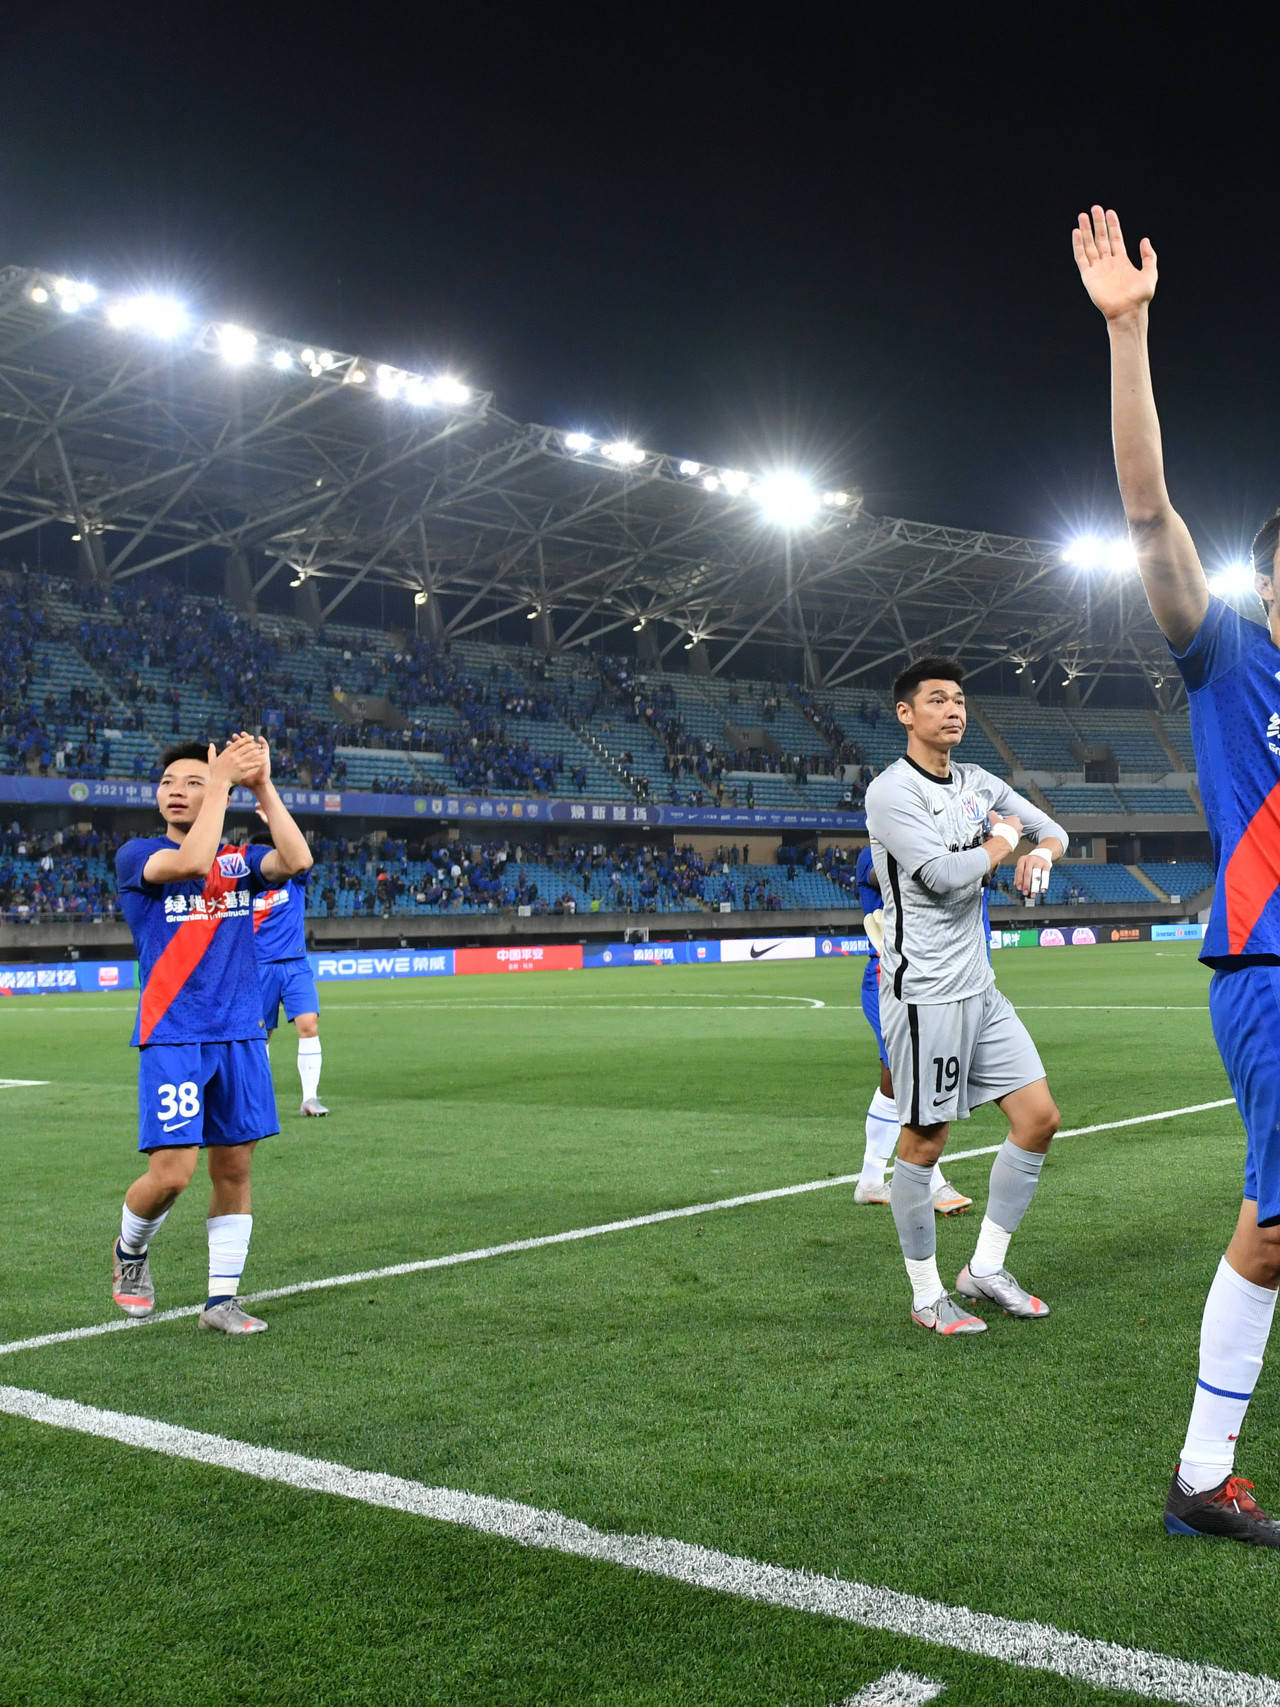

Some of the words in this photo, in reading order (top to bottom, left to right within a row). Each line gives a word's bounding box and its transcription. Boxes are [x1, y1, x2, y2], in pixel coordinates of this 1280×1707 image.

[318, 957, 410, 975] ROEWE
[413, 956, 446, 971] 荣威
[496, 948, 544, 962] 中国平安
[933, 1056, 960, 1093] 19
[157, 1081, 200, 1121] 38
